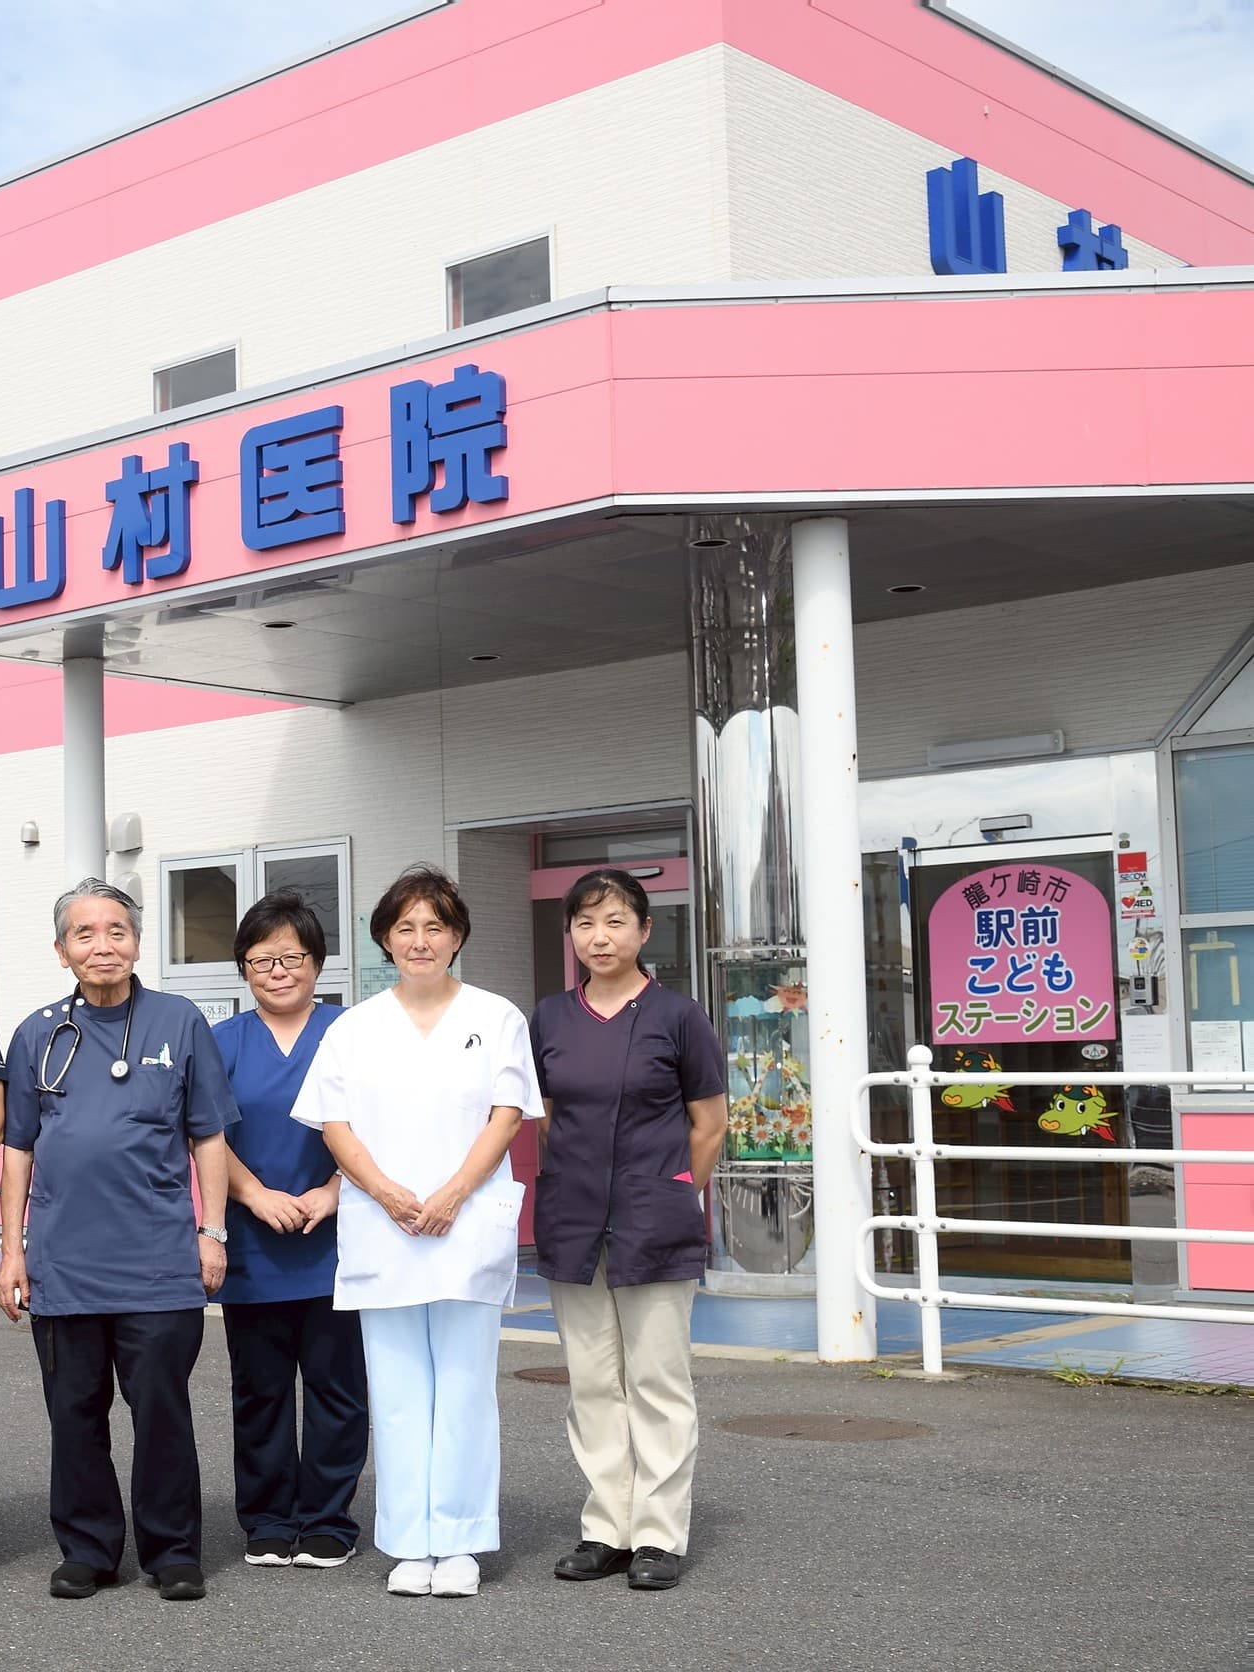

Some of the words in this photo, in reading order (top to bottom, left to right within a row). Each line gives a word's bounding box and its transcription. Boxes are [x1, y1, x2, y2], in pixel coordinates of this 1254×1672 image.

[1120, 872, 1146, 881] SECOM
[1133, 899, 1153, 908] AED
[976, 905, 1059, 948] 駅前
[967, 953, 1074, 995] こども
[937, 998, 1110, 1035] ステーション
